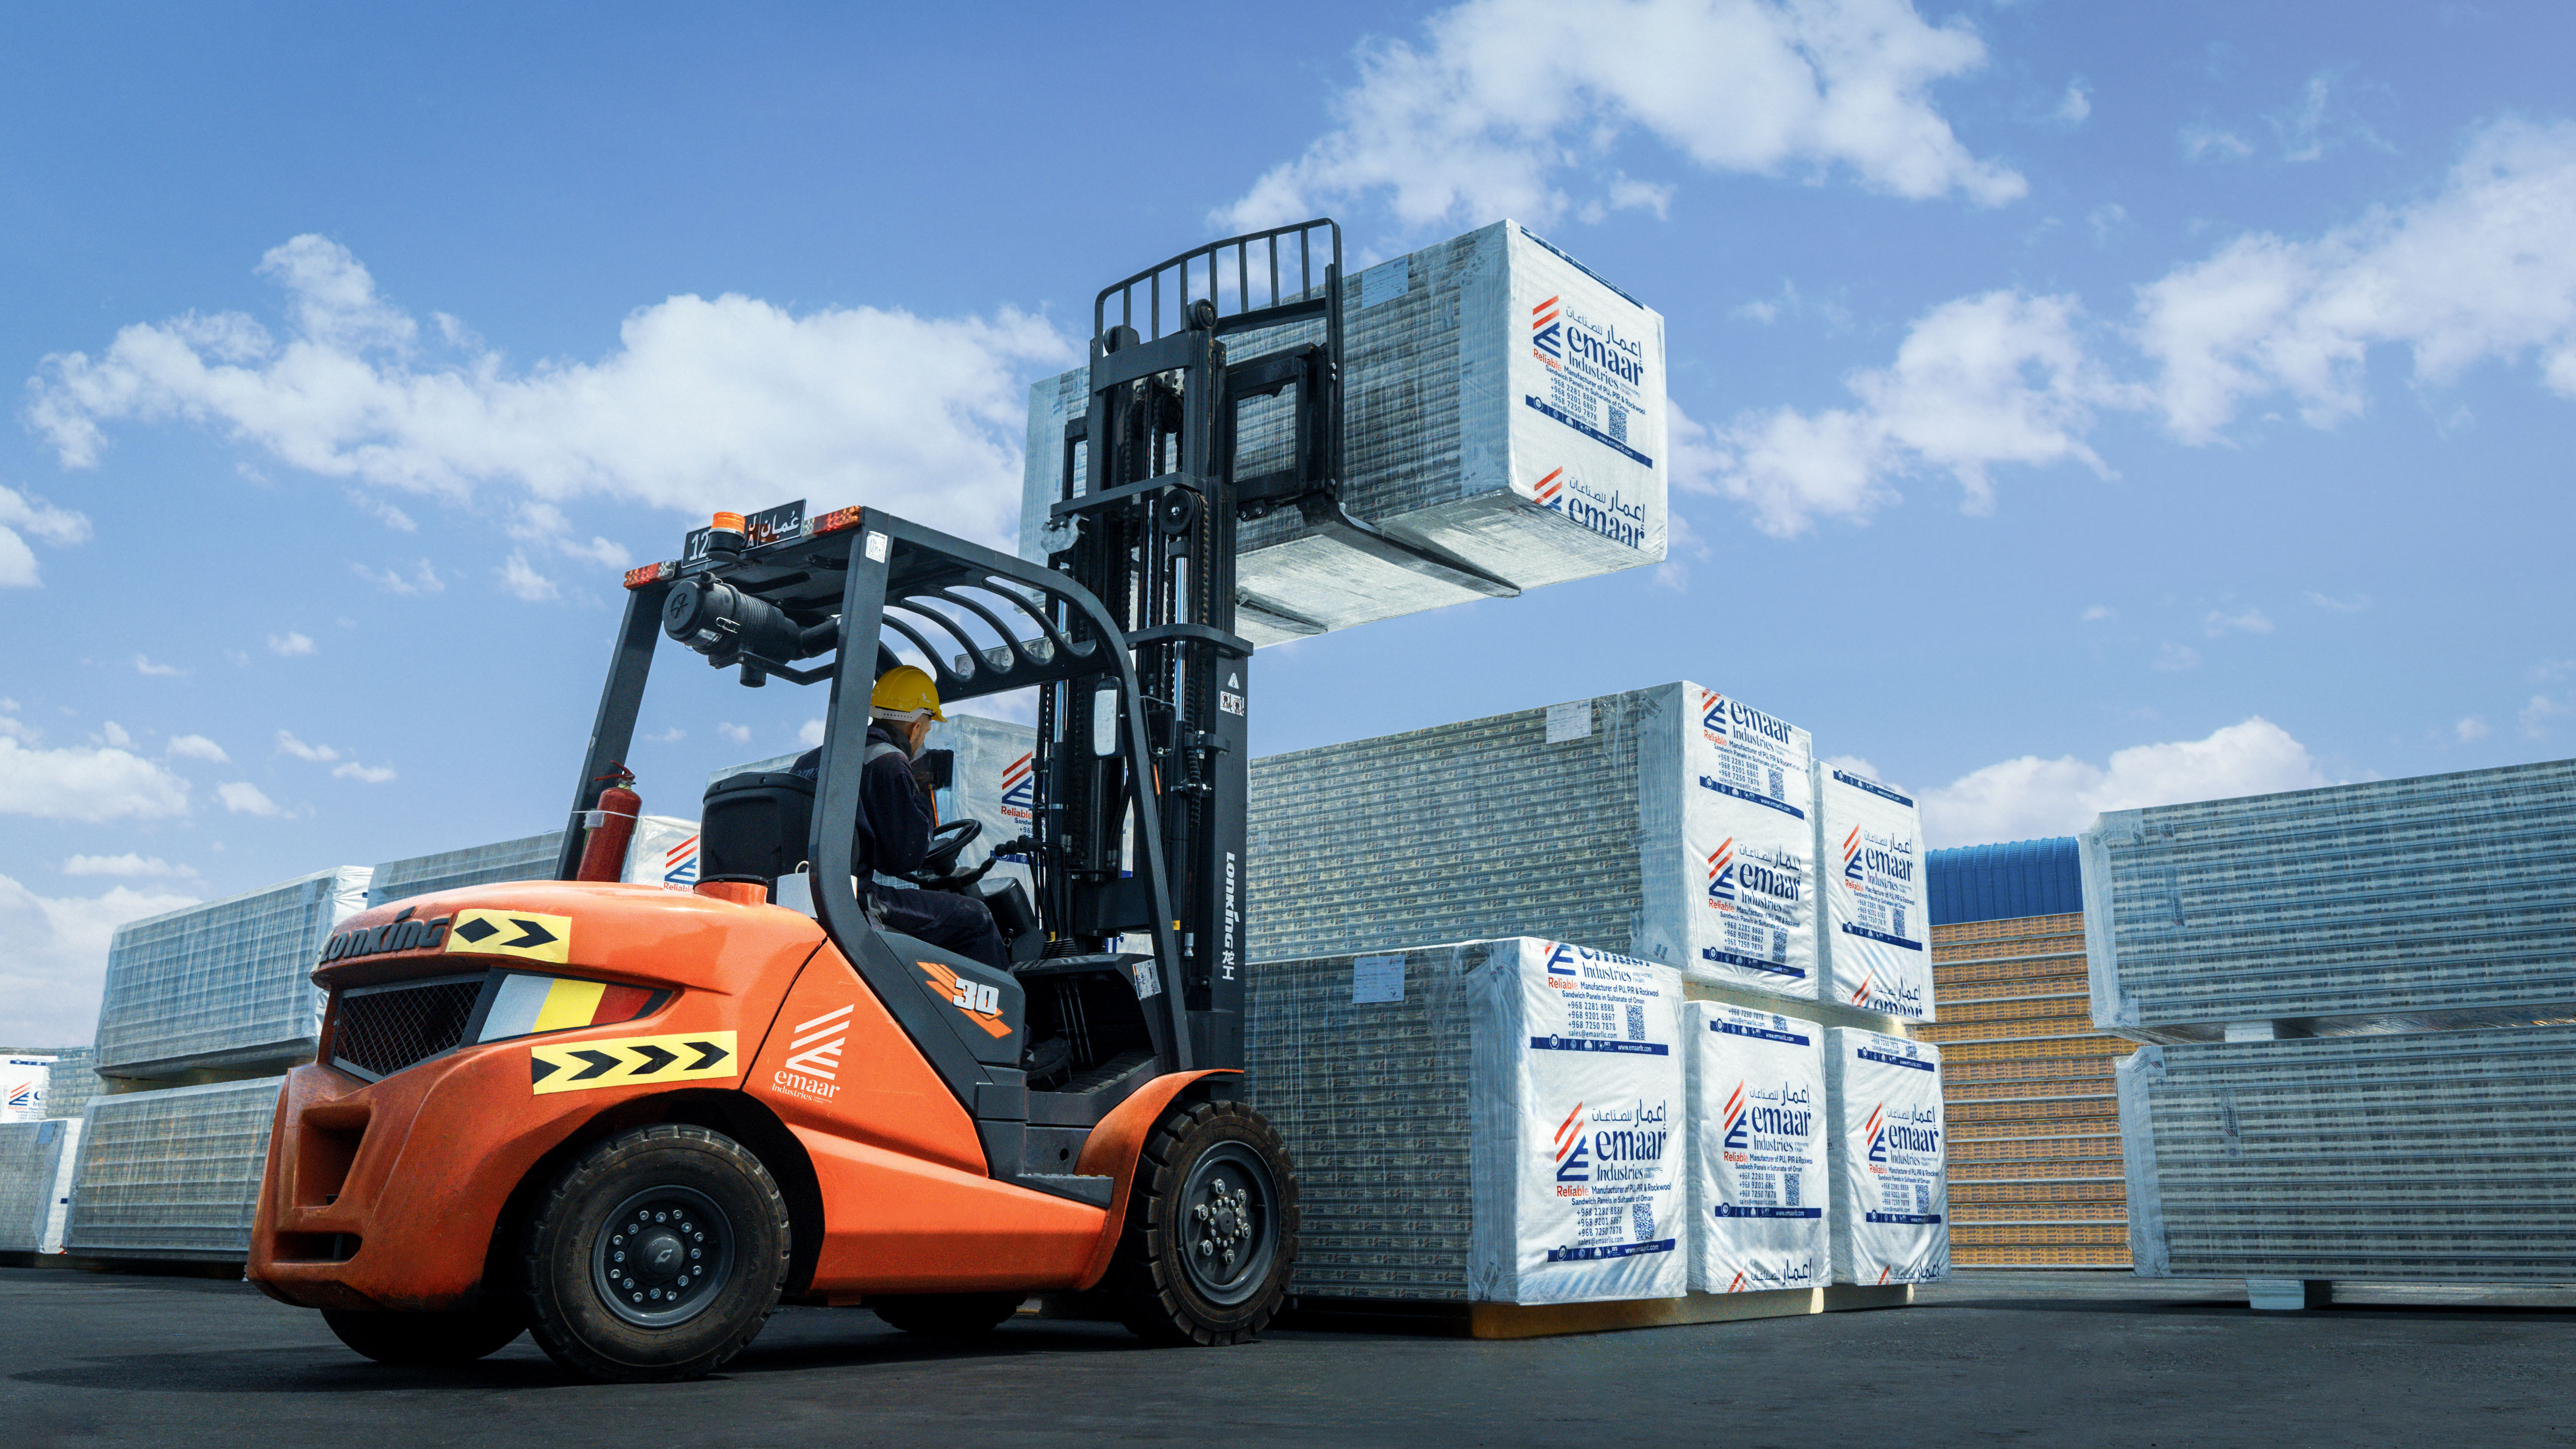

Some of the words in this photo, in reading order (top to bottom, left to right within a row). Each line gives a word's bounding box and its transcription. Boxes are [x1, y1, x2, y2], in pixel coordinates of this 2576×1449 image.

[1566, 306, 1602, 335] للصناعات
[1606, 325, 1642, 365] إعمار
[1533, 348, 1562, 372] Reliable
[1567, 327, 1643, 386] emaar
[1564, 366, 1596, 389] Manufacturer
[1569, 351, 1618, 390] Industries
[1546, 364, 1568, 383] Sandwich
[1569, 377, 1584, 391] Panels
[1585, 386, 1589, 394] in
[1590, 388, 1611, 405] Sultanate
[1551, 376, 1564, 390] +968
[1567, 383, 1581, 397] 2281
[1583, 390, 1597, 405] 8888
[1551, 385, 1564, 398] +968
[1567, 392, 1581, 406] 9201
[1583, 398, 1597, 413] 6867
[1551, 394, 1564, 407] +968
[1567, 400, 1581, 414] 7250
[1583, 407, 1597, 421] 7878
[1551, 401, 1598, 429] sales@emaarllc.com
[1597, 433, 1633, 456] www.emaarllc.com
[1570, 477, 1606, 503] للصناعات
[1609, 490, 1645, 530] إعمار
[1569, 498, 1644, 549] emaar
[746, 534, 754, 548] A
[1731, 701, 1792, 745] emaar
[1704, 730, 1727, 747] Reliable
[1733, 725, 1774, 752] Industries
[1714, 743, 1732, 756] Sandwich
[1734, 749, 1747, 760] Panels
[1729, 740, 1757, 756] Manufacturer
[1718, 754, 1729, 764] +968
[1732, 757, 1744, 767] 2281
[1747, 760, 1758, 771] 8888
[1718, 761, 1730, 771] +968
[1732, 765, 1745, 775] 9201
[1747, 768, 1759, 778] 6867
[1719, 770, 1730, 779] +968
[1733, 772, 1745, 783] 7250
[1748, 776, 1760, 786] 7878
[1001, 806, 1032, 819] Reliable
[1014, 818, 1033, 826] Sandw
[1890, 833, 1912, 861] إعمار
[1865, 847, 1913, 882] emaar
[664, 882, 694, 893] Reliable
[1739, 864, 1801, 901] emaar
[1846, 879, 1864, 892] Reliable
[1867, 871, 1898, 890] Industries
[1709, 899, 1734, 912] Reliable
[1741, 889, 1782, 912] Industries
[1720, 911, 1739, 923] Sandwich
[1724, 921, 1736, 931] +968
[1738, 923, 1750, 933] 2281
[1752, 926, 1763, 935] 8888
[1724, 930, 1736, 939] +968
[1738, 932, 1749, 941] 9201
[1752, 934, 1763, 943] 6867
[1724, 946, 1763, 958] sales@emaarllc.com
[1725, 938, 1737, 947] +968
[1738, 940, 1749, 949] 7250
[1752, 942, 1763, 951] 7878
[1583, 962, 1631, 982] Industries
[1549, 977, 1578, 990] Reliable
[1581, 982, 1612, 992] Manufacturer
[1614, 985, 1618, 993] of
[1640, 987, 1659, 997] Rockwool
[953, 978, 999, 1015] 30
[1562, 991, 1585, 1000] Sandwich
[1586, 993, 1601, 1001] Panels
[1607, 994, 1627, 1003] Sultanate
[1568, 1001, 1582, 1010] +968
[1585, 1002, 1598, 1011] 2281
[1601, 1003, 1614, 1012] 8888
[1585, 1012, 1599, 1020] 9201
[1602, 1013, 1614, 1021] 6867
[1568, 1021, 1583, 1029] +968
[1586, 1022, 1599, 1030] 7250
[1602, 1023, 1616, 1031] 7878
[1568, 1030, 1617, 1039] sales@emaarllc.com
[772, 1083, 813, 1100] Industries
[775, 1071, 840, 1098] emaar
[1750, 1087, 1778, 1100] للصناعات
[1782, 1082, 1809, 1110] إعمار
[1592, 1108, 1631, 1121] للصناعات
[1635, 1099, 1666, 1130] إعمار
[1752, 1107, 1811, 1136] emaar
[1887, 1107, 1909, 1119] للصناعات
[1912, 1104, 1935, 1129] إعمار
[1596, 1131, 1666, 1161] emaar
[1754, 1135, 1793, 1152] Industries
[1889, 1125, 1939, 1152] emaar
[1724, 1151, 1748, 1162] Reliable
[1750, 1154, 1774, 1162] Manufacturer
[1890, 1151, 1920, 1167] Industries
[1597, 1164, 1643, 1181] Industries
[1557, 1185, 1589, 1197] Reliable
[1592, 1184, 1624, 1195] Manufacturer
[1648, 1182, 1671, 1192] Rockwool
[1572, 1197, 1596, 1205] Sandwich
[1597, 1196, 1612, 1204] Panels
[1577, 1208, 1592, 1216] +968
[1595, 1207, 1608, 1215] 2281
[1610, 1206, 1623, 1215] 8888
[1577, 1218, 1592, 1227] +968
[1595, 1217, 1608, 1226] 9201
[1578, 1228, 1593, 1237] +968
[1596, 1227, 1608, 1236] 7250
[1610, 1227, 1622, 1235] 7878
[1578, 1237, 1624, 1245] sales@emaarllc.com
[1783, 1258, 1812, 1285] إعمار
